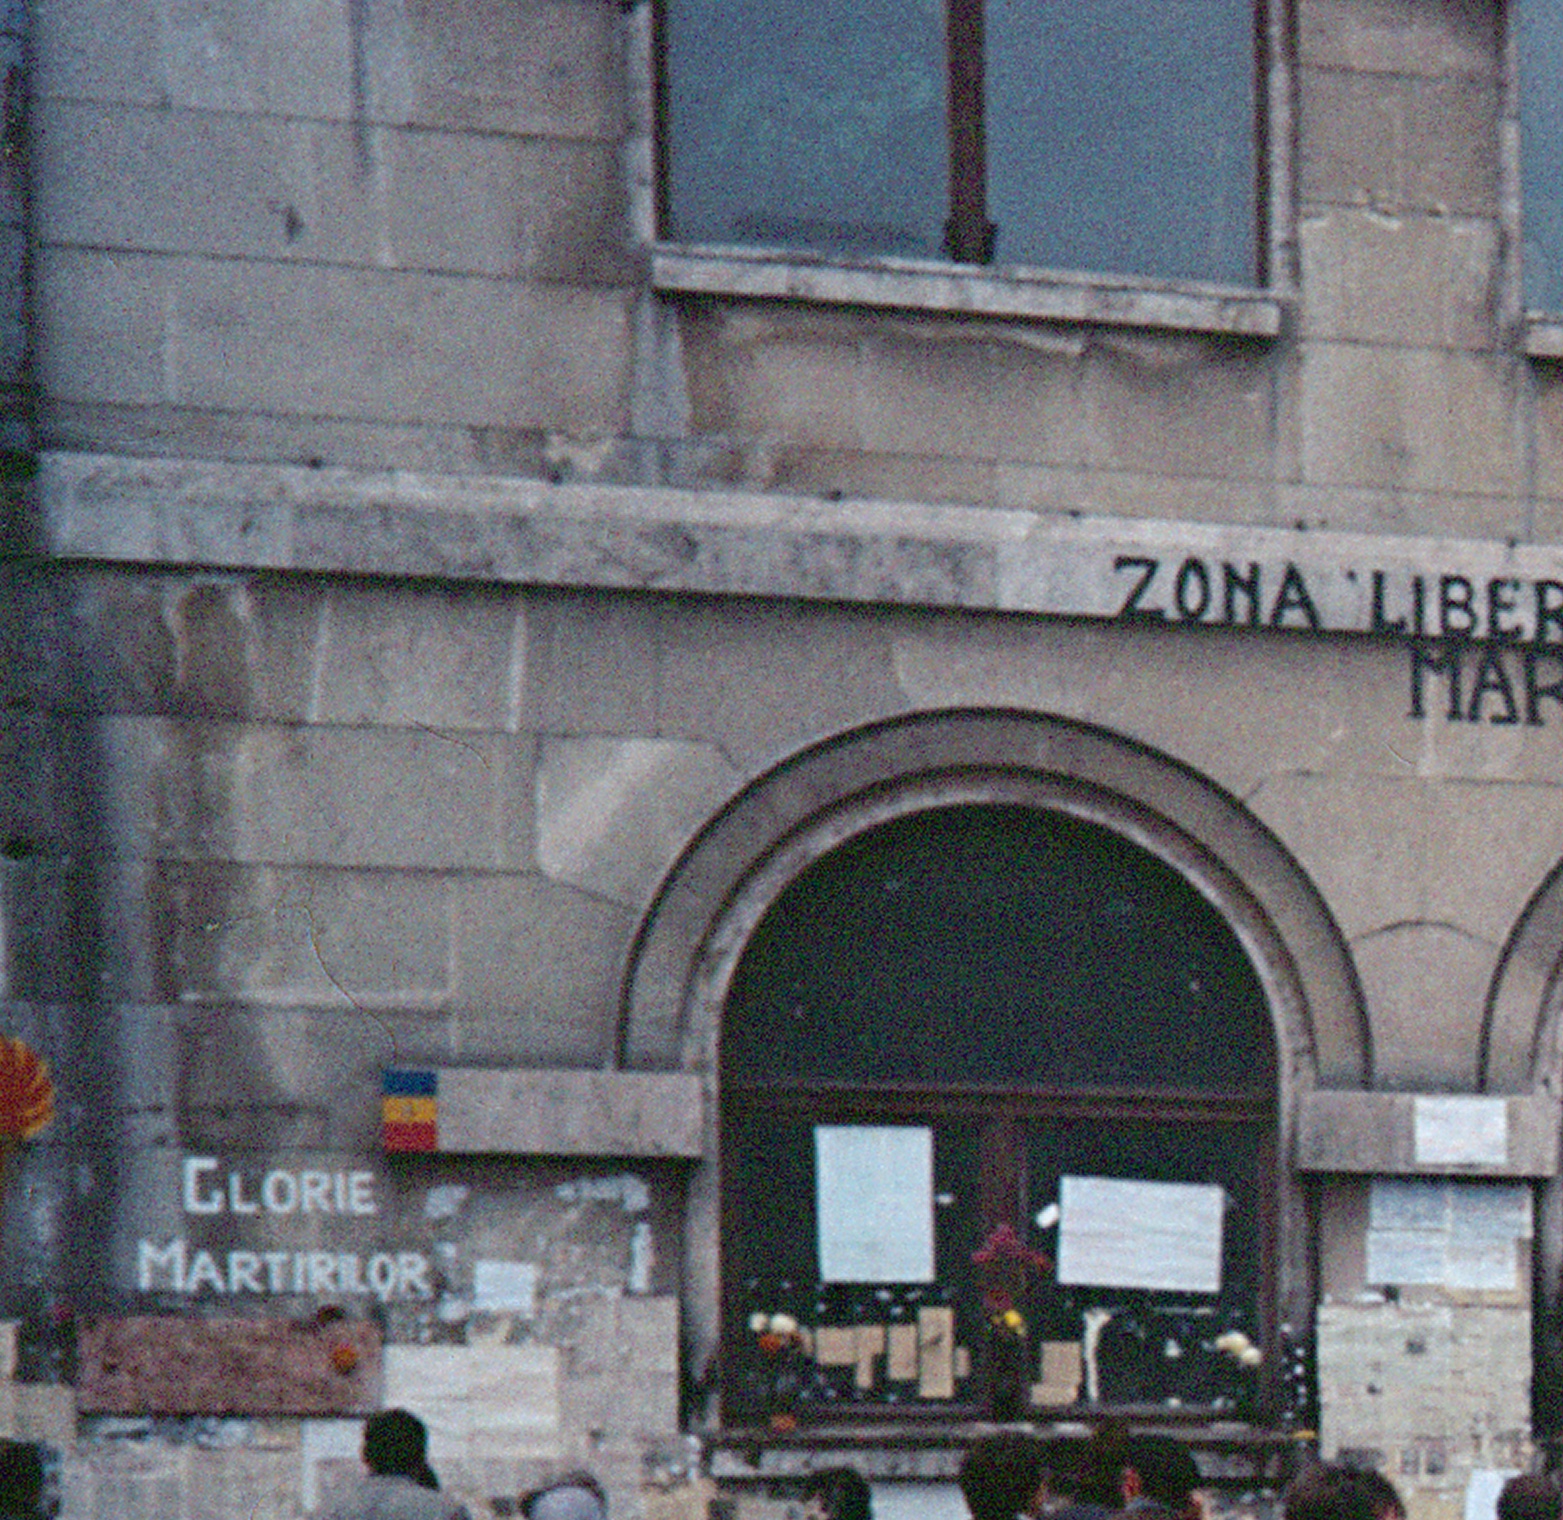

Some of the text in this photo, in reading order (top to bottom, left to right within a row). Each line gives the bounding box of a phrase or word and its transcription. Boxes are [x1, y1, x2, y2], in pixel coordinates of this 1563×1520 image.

[1112, 554, 1322, 632] ZONA
[183, 1156, 378, 1215] GLORIE
[137, 1238, 433, 1302] MARTIRILOR
